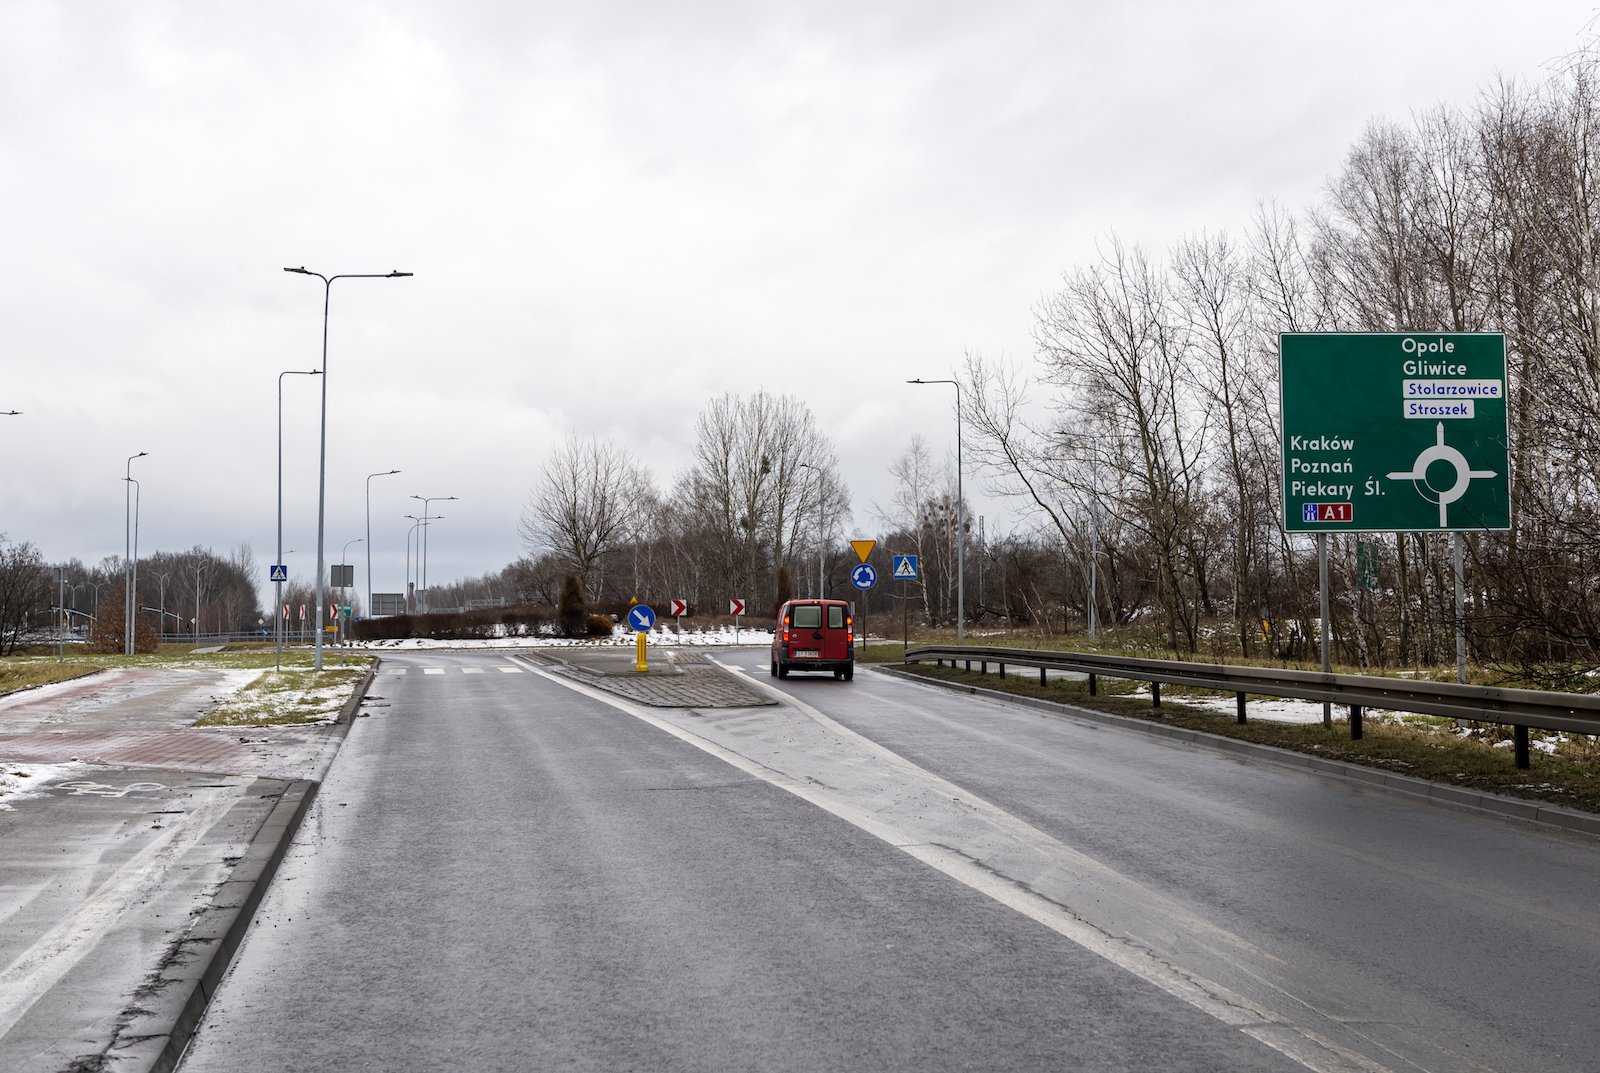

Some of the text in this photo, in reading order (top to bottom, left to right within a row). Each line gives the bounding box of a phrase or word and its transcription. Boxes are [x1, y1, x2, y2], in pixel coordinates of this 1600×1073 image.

[1402, 338, 1455, 357] Opole
[1403, 360, 1467, 376] Gliwice
[1409, 383, 1498, 395] Stolarzowice
[1409, 403, 1468, 415] Stroszek
[1290, 435, 1354, 451] Kraków
[1291, 458, 1353, 474] Poznań
[1292, 477, 1386, 500] Piekary Śl.
[1324, 506, 1346, 519] A1
